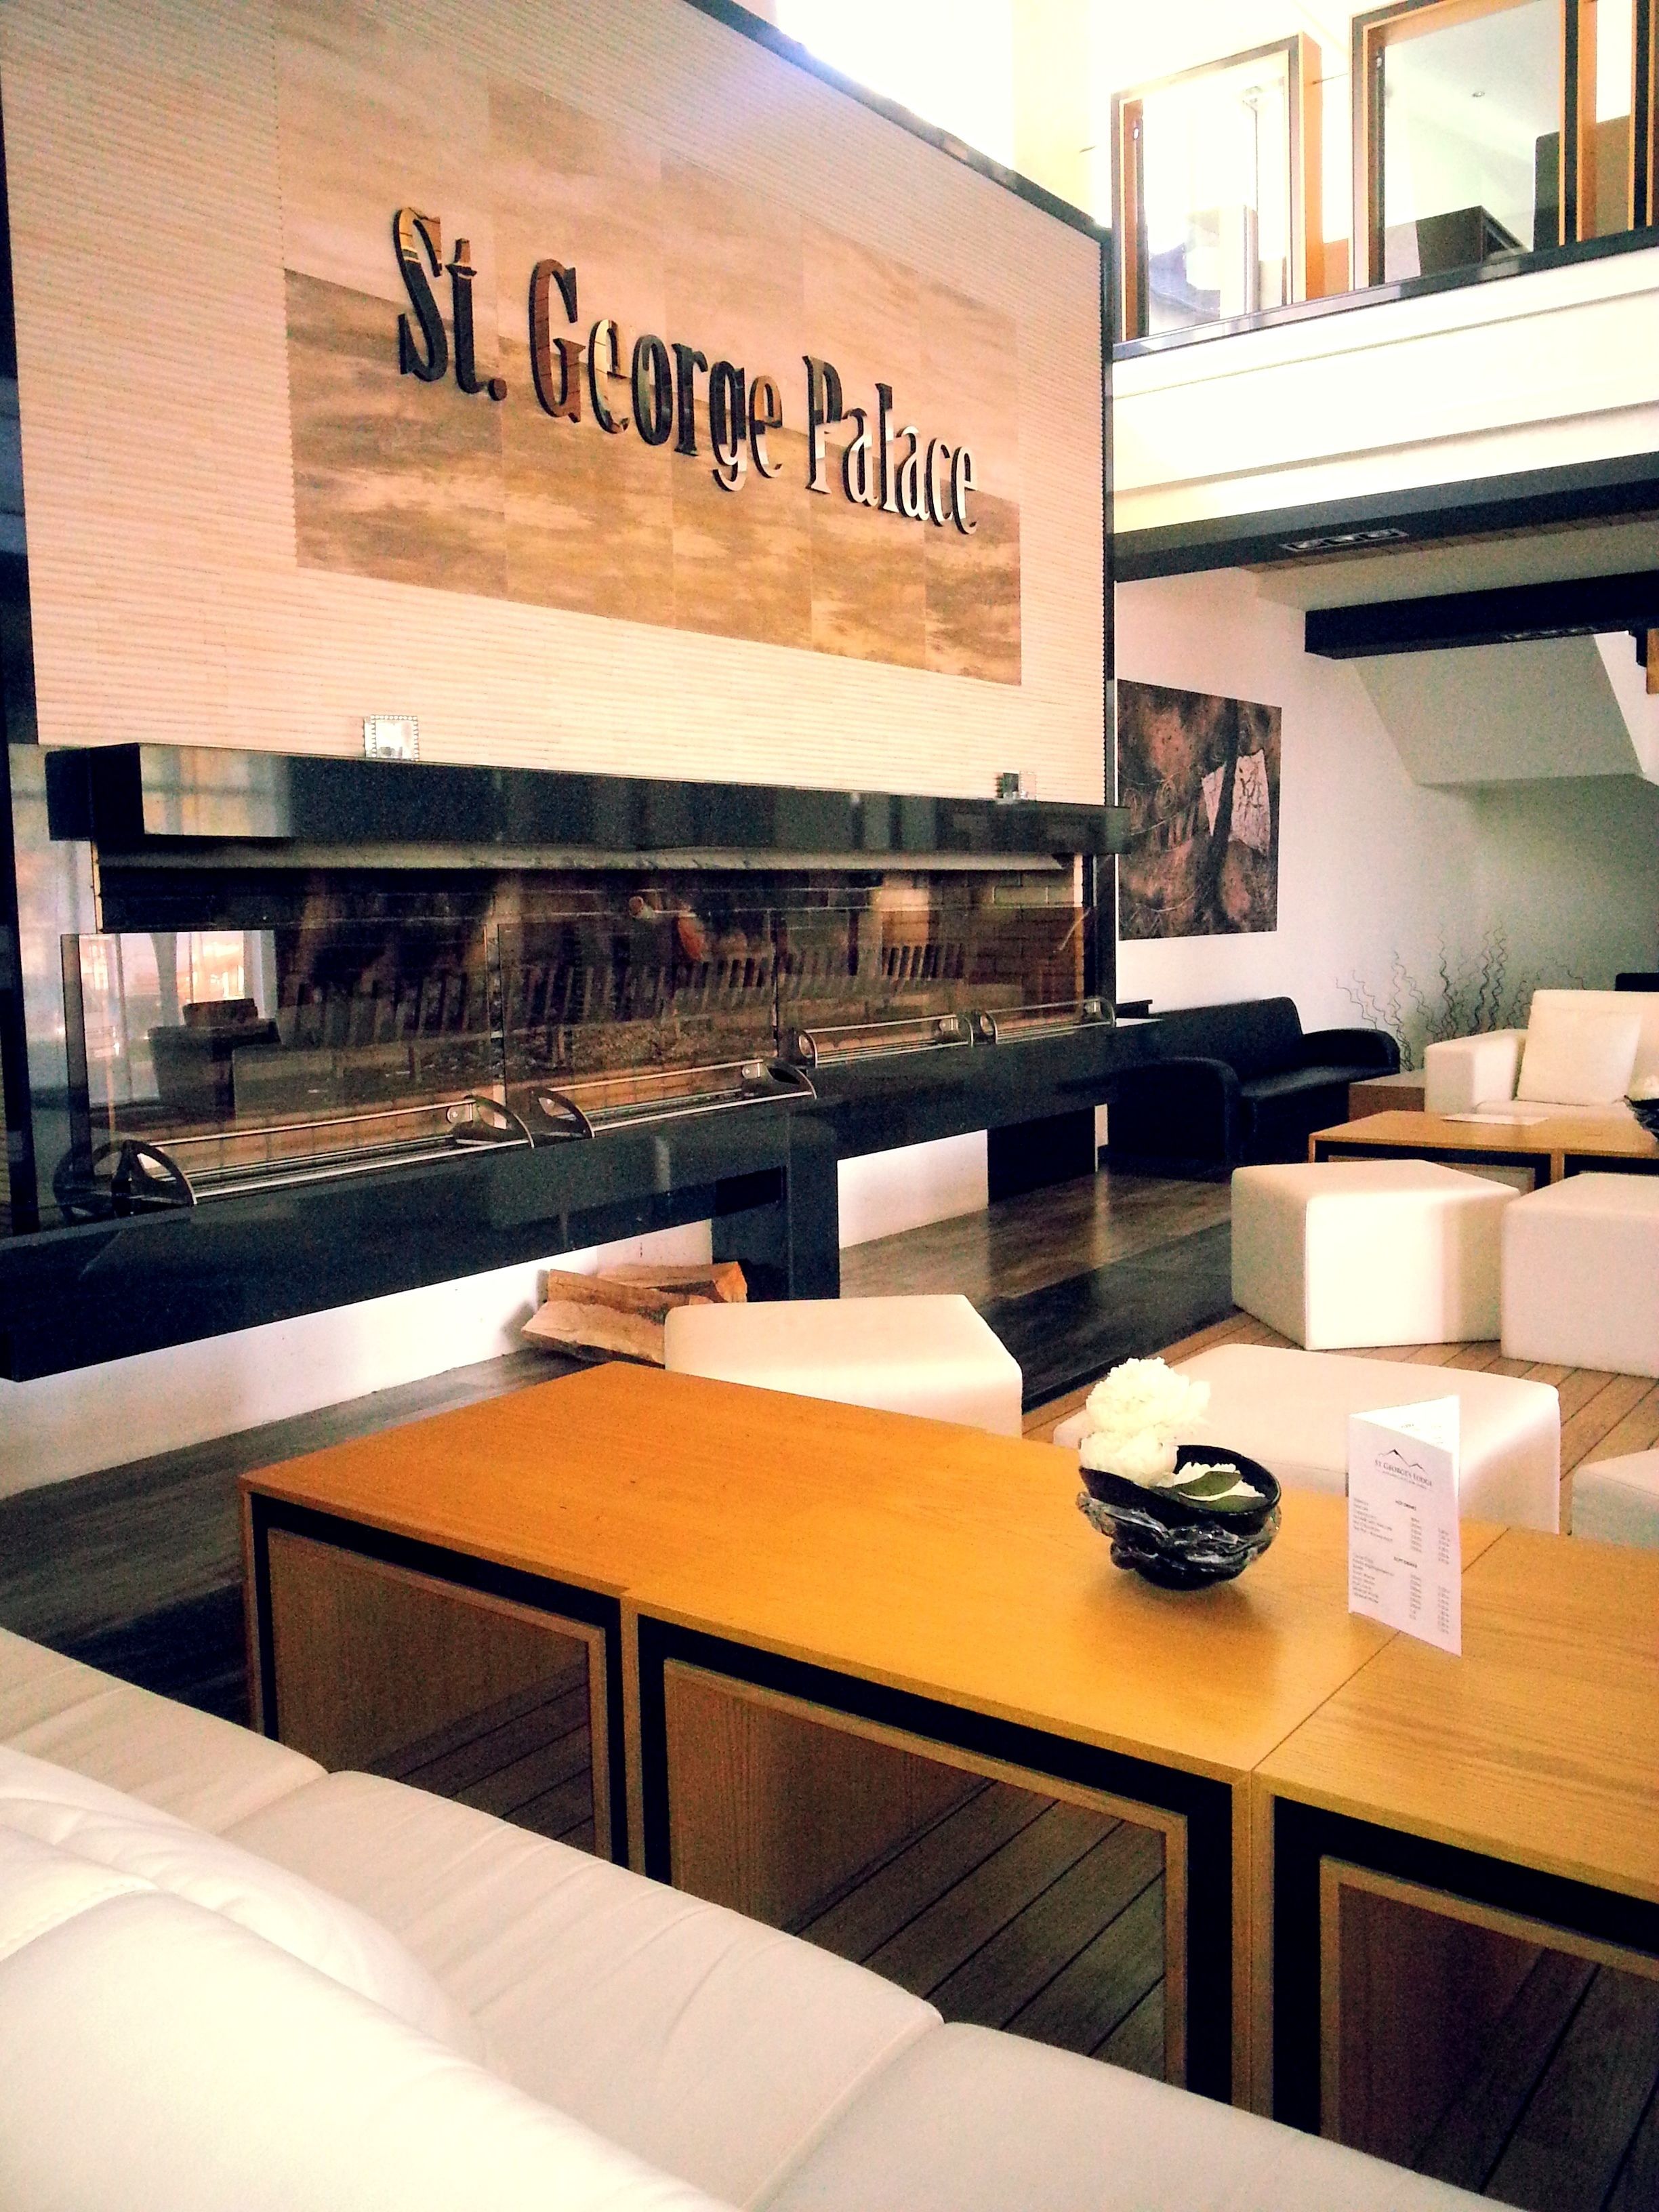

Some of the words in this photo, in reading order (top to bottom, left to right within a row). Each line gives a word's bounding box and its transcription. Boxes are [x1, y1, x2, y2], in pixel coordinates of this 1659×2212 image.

[393, 207, 507, 401] St.
[529, 258, 783, 492] George
[802, 355, 979, 535] Palace
